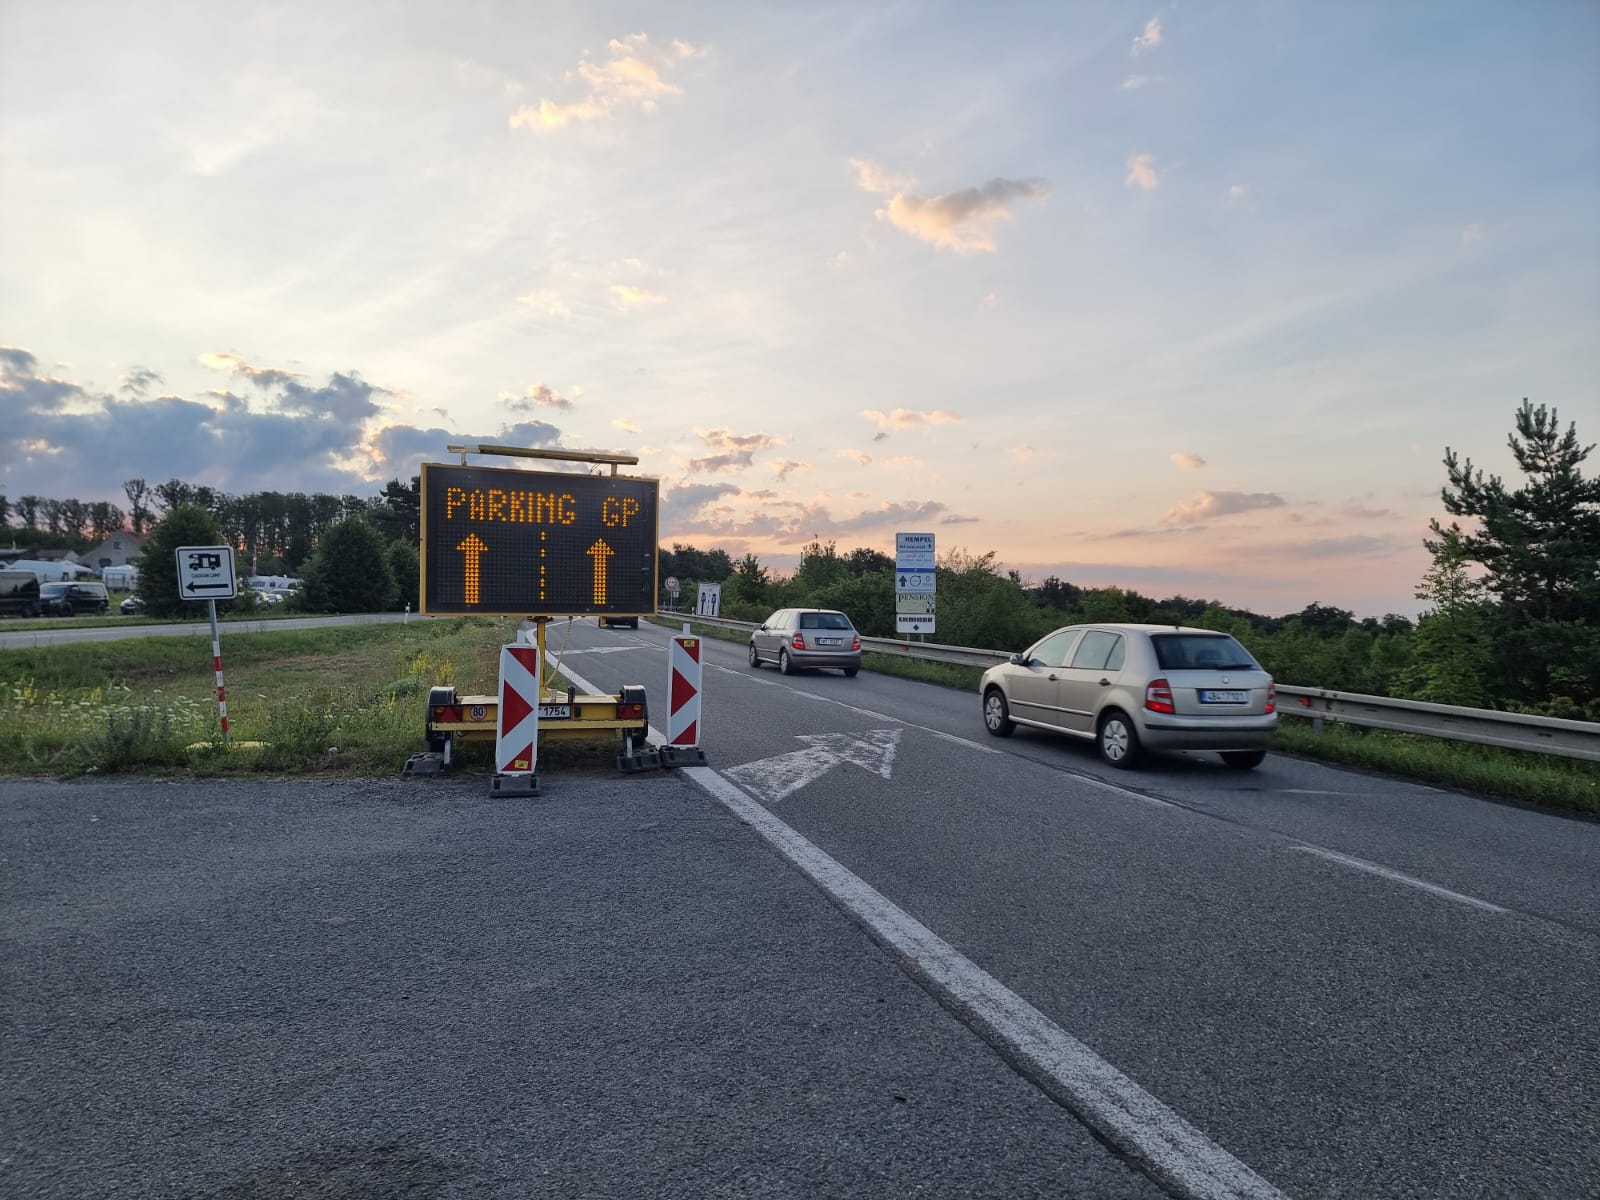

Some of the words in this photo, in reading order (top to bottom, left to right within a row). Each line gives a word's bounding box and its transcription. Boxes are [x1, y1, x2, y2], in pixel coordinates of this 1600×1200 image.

[447, 487, 577, 524] PARKING
[602, 497, 640, 527] GP
[898, 594, 934, 603] PENSION
[473, 707, 483, 717] 80
